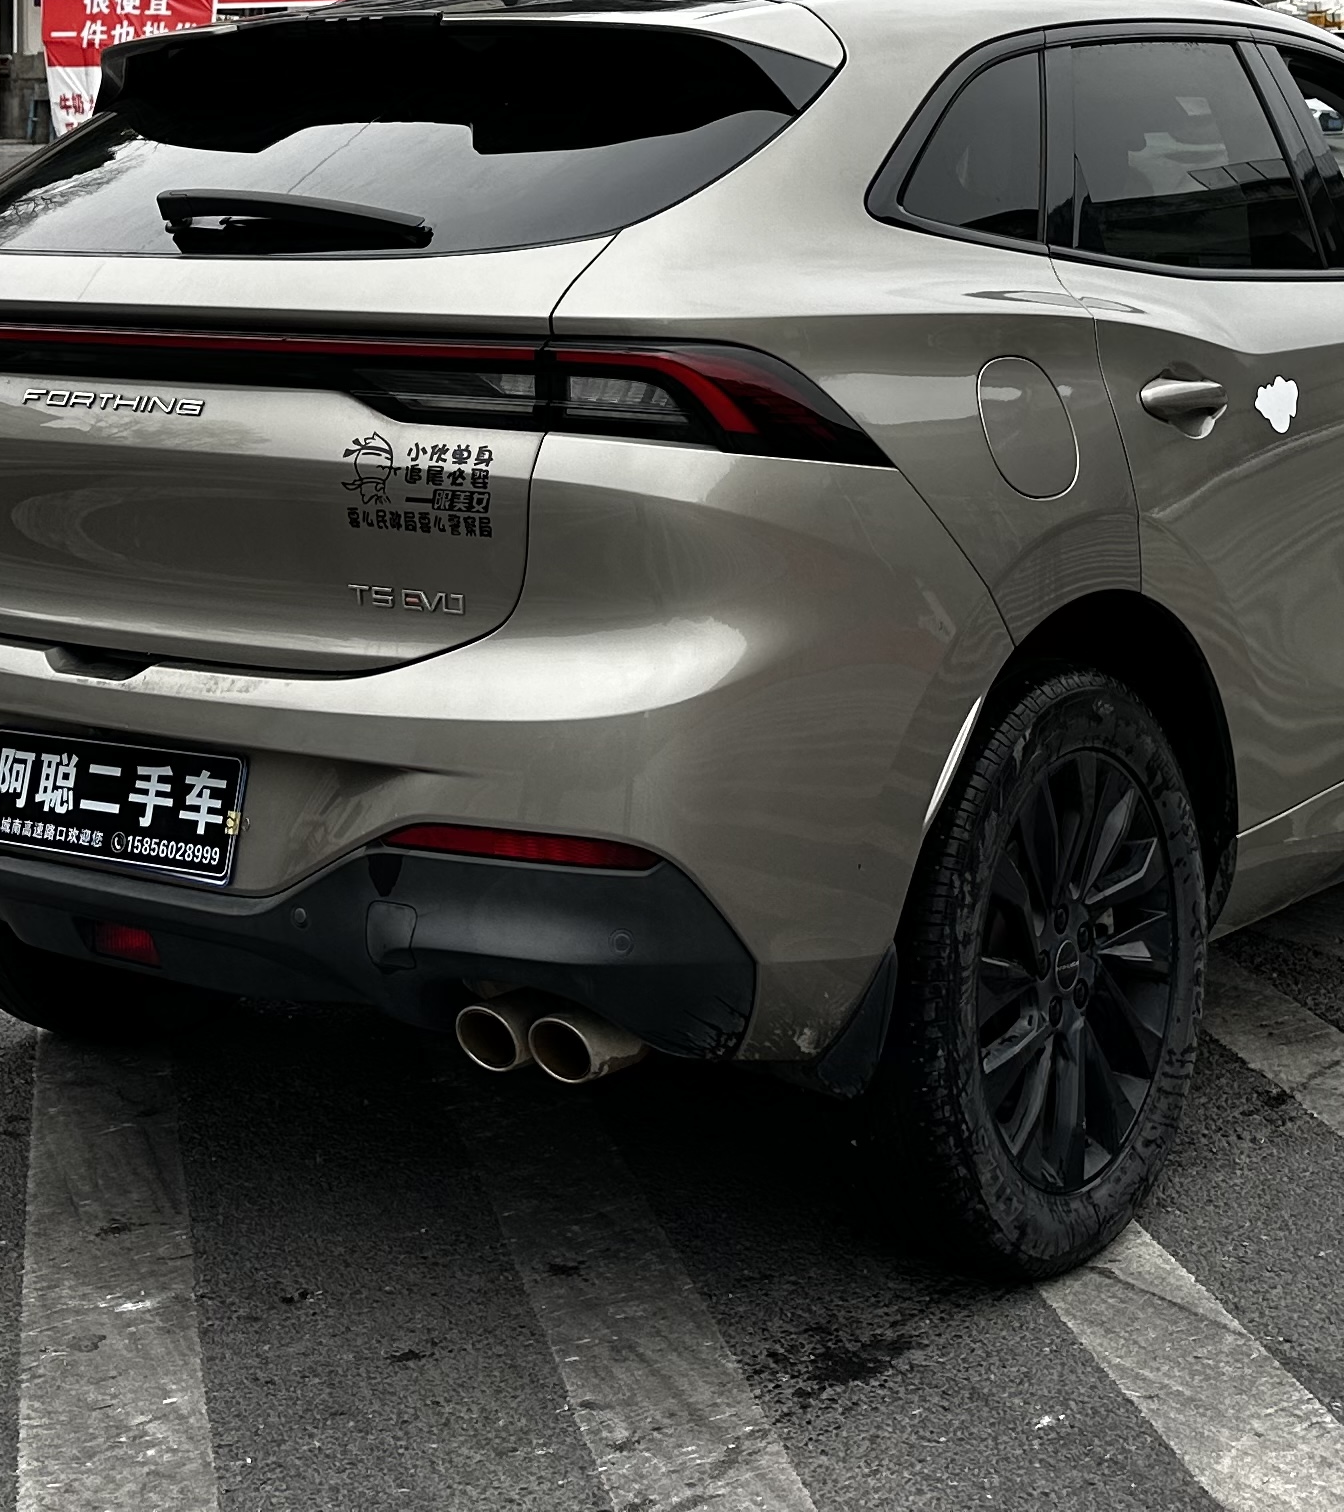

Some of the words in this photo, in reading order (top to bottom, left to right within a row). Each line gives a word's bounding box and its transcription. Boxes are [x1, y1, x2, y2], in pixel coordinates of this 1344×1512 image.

[23, 388, 205, 416] FORTHING
[401, 589, 466, 615] EVO
[0, 816, 104, 848] 城南高速路口欢迎您
[126, 834, 221, 866] 15856028999
